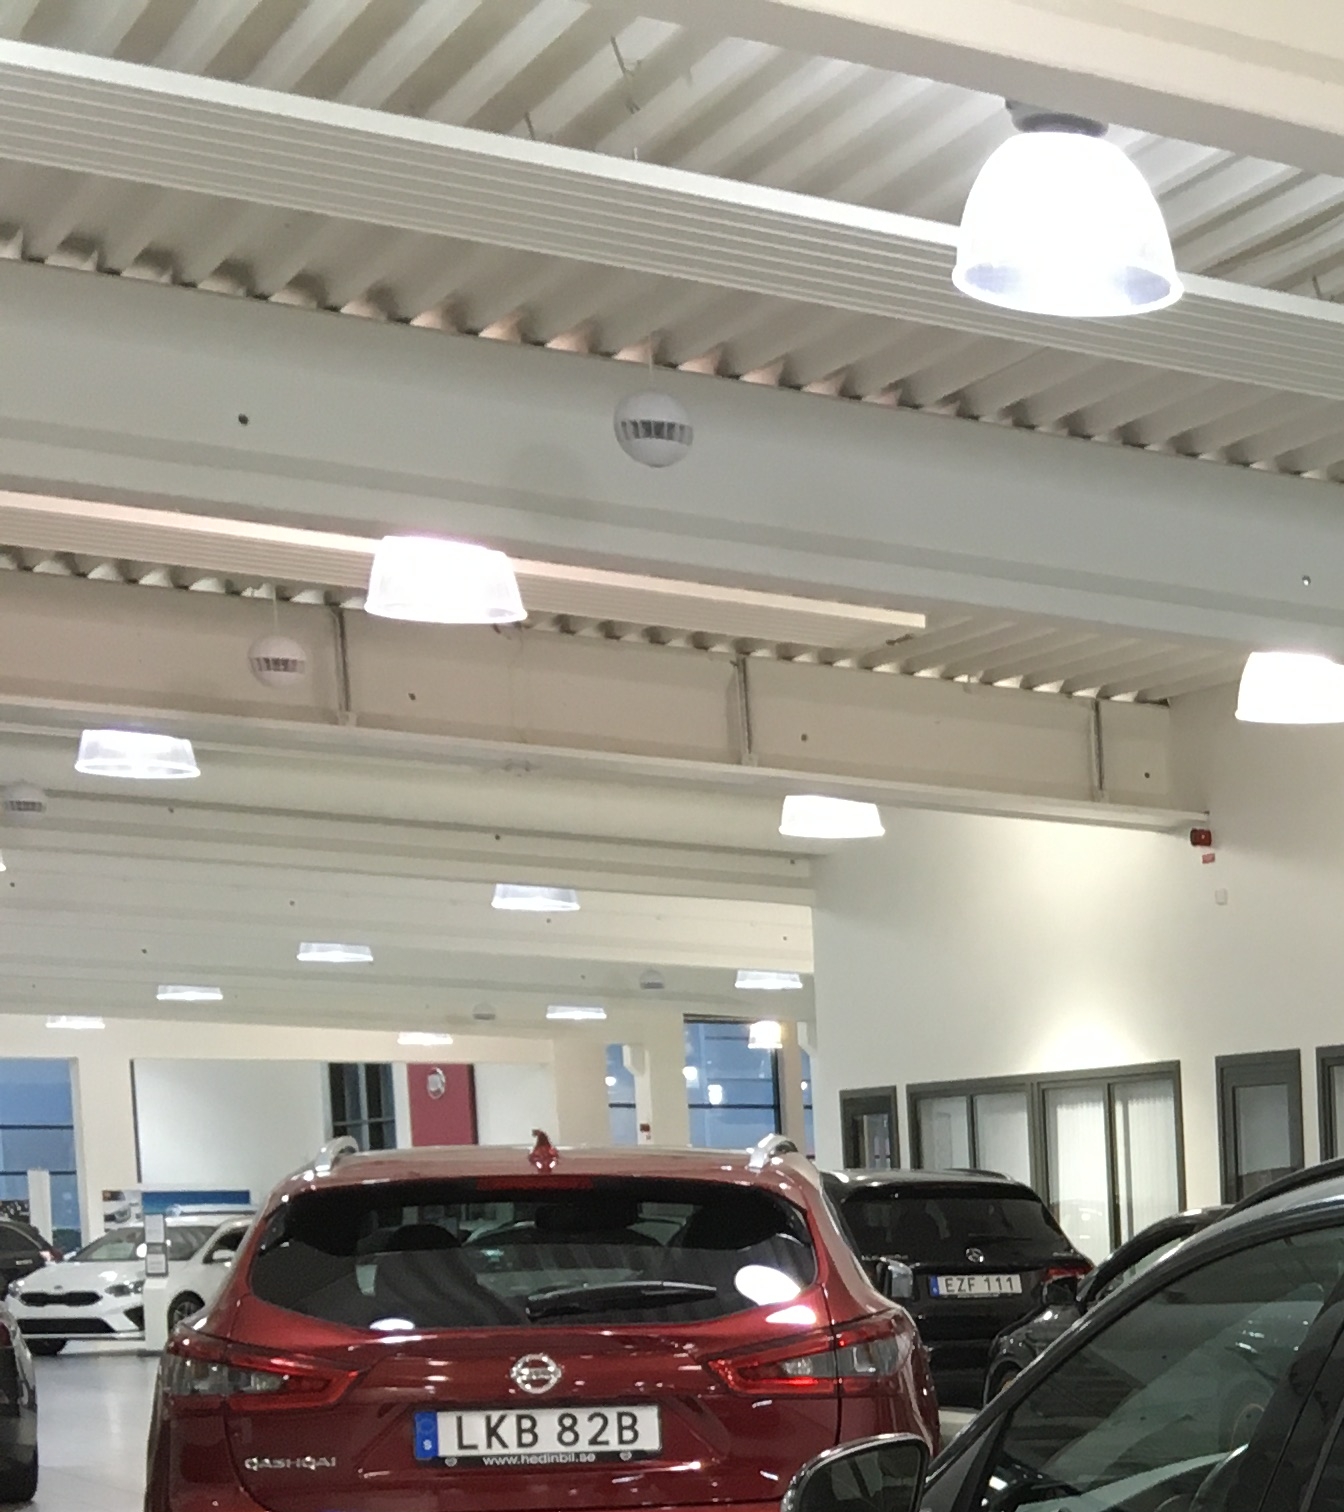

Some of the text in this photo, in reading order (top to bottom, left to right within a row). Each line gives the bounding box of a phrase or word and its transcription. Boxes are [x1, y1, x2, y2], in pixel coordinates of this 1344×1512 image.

[945, 1277, 975, 1293] EZF
[984, 1276, 1014, 1292] 111
[455, 1411, 641, 1452] LKB 82B
[244, 1456, 336, 1471] QASHQAI
[482, 1452, 596, 1467] www.hedinbil.se
